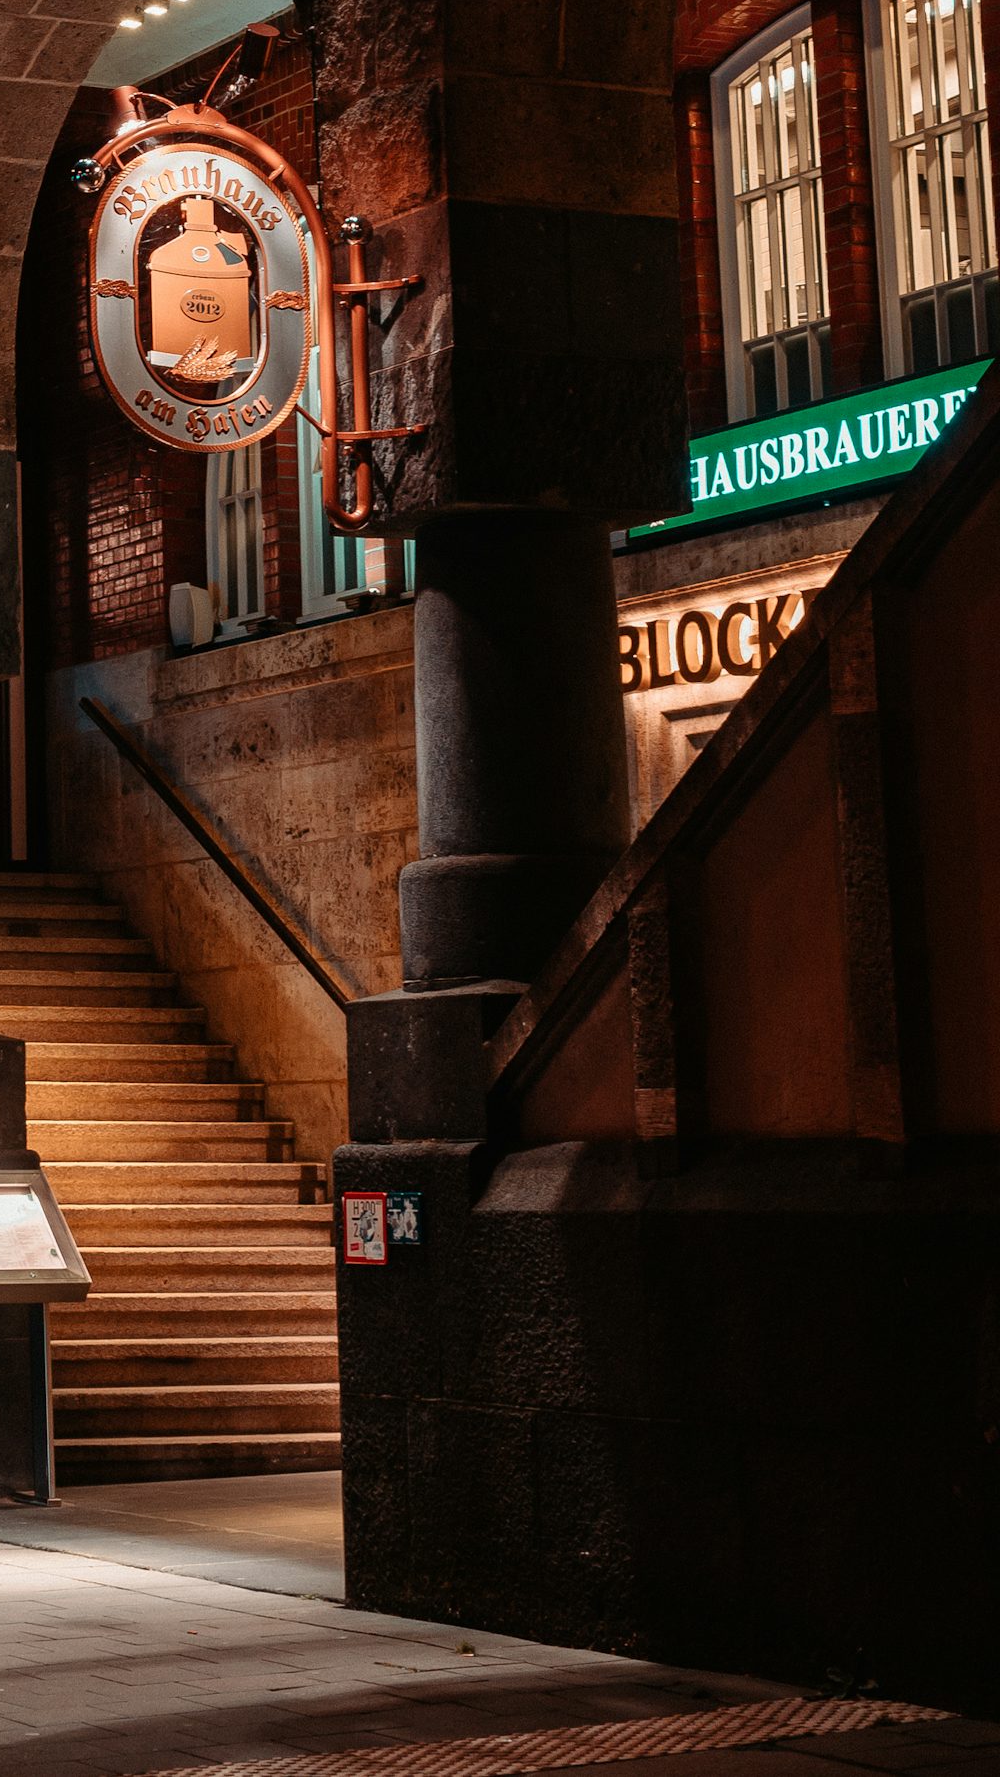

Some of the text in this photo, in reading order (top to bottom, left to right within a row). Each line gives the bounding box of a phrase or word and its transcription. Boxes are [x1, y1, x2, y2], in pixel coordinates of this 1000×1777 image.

[113, 158, 283, 232] Brauhaus
[186, 301, 221, 316] 2012
[134, 388, 274, 442] am Hafen
[689, 385, 978, 502] HAUSBRAUERE
